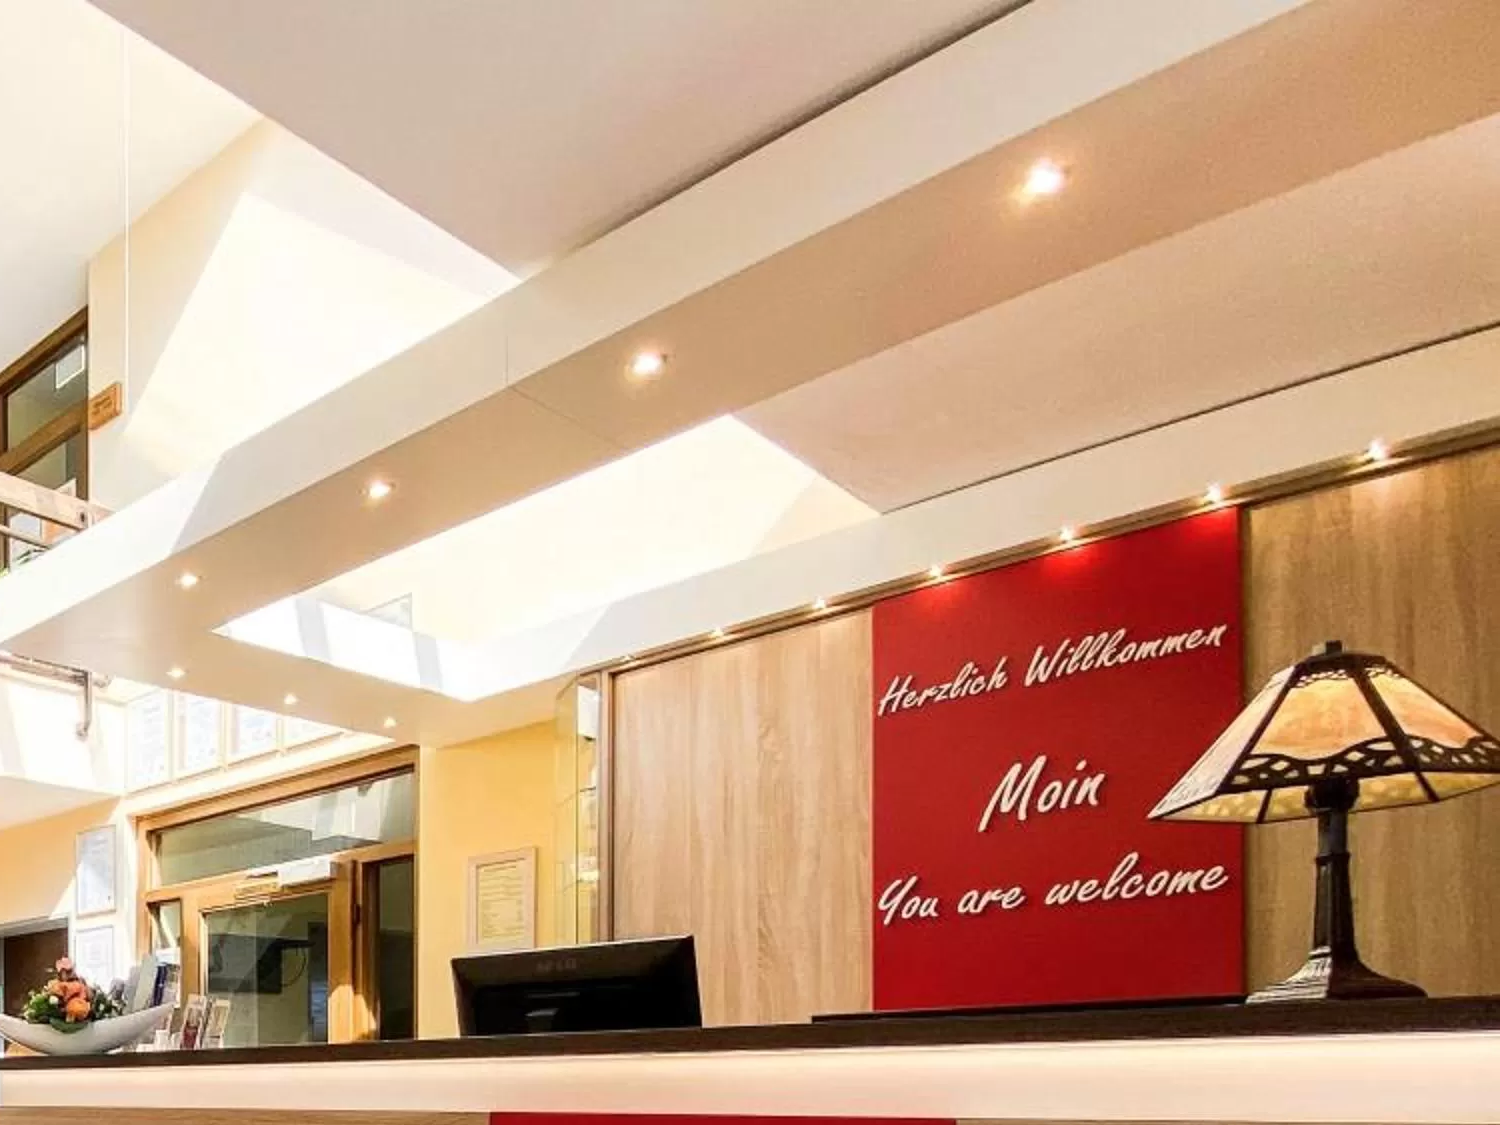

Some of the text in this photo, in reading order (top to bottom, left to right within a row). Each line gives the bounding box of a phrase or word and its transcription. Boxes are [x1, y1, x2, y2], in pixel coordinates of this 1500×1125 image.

[877, 624, 1227, 717] Herzlich Willkommen
[978, 755, 1106, 833] Moin
[877, 851, 1230, 926] You are welcome
